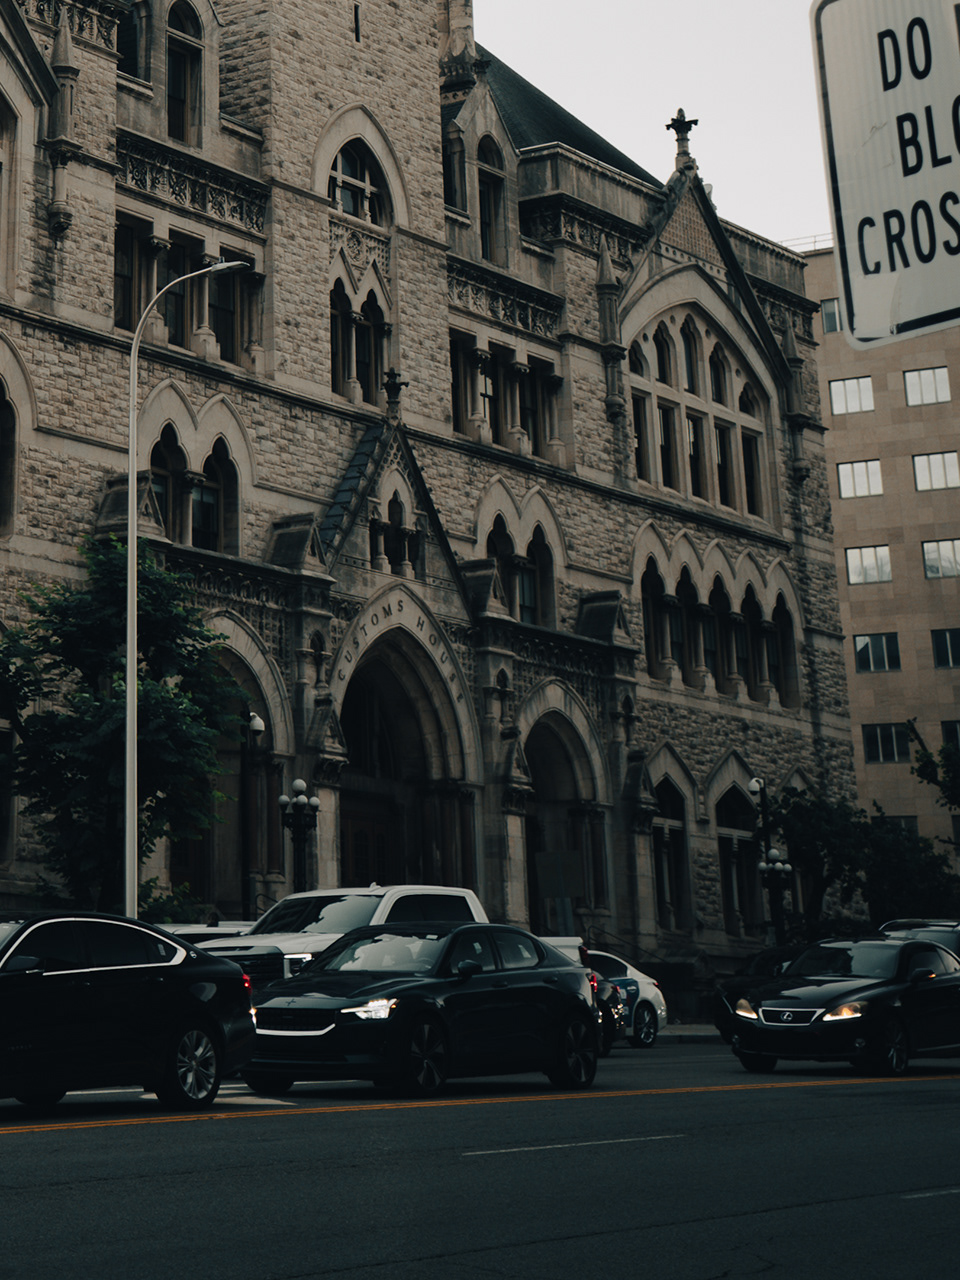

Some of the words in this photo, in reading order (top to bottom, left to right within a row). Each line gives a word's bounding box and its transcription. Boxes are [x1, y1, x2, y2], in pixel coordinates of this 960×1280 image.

[877, 17, 932, 92] DO
[337, 599, 404, 682] CUSTOMS
[416, 616, 463, 703] HOUSE
